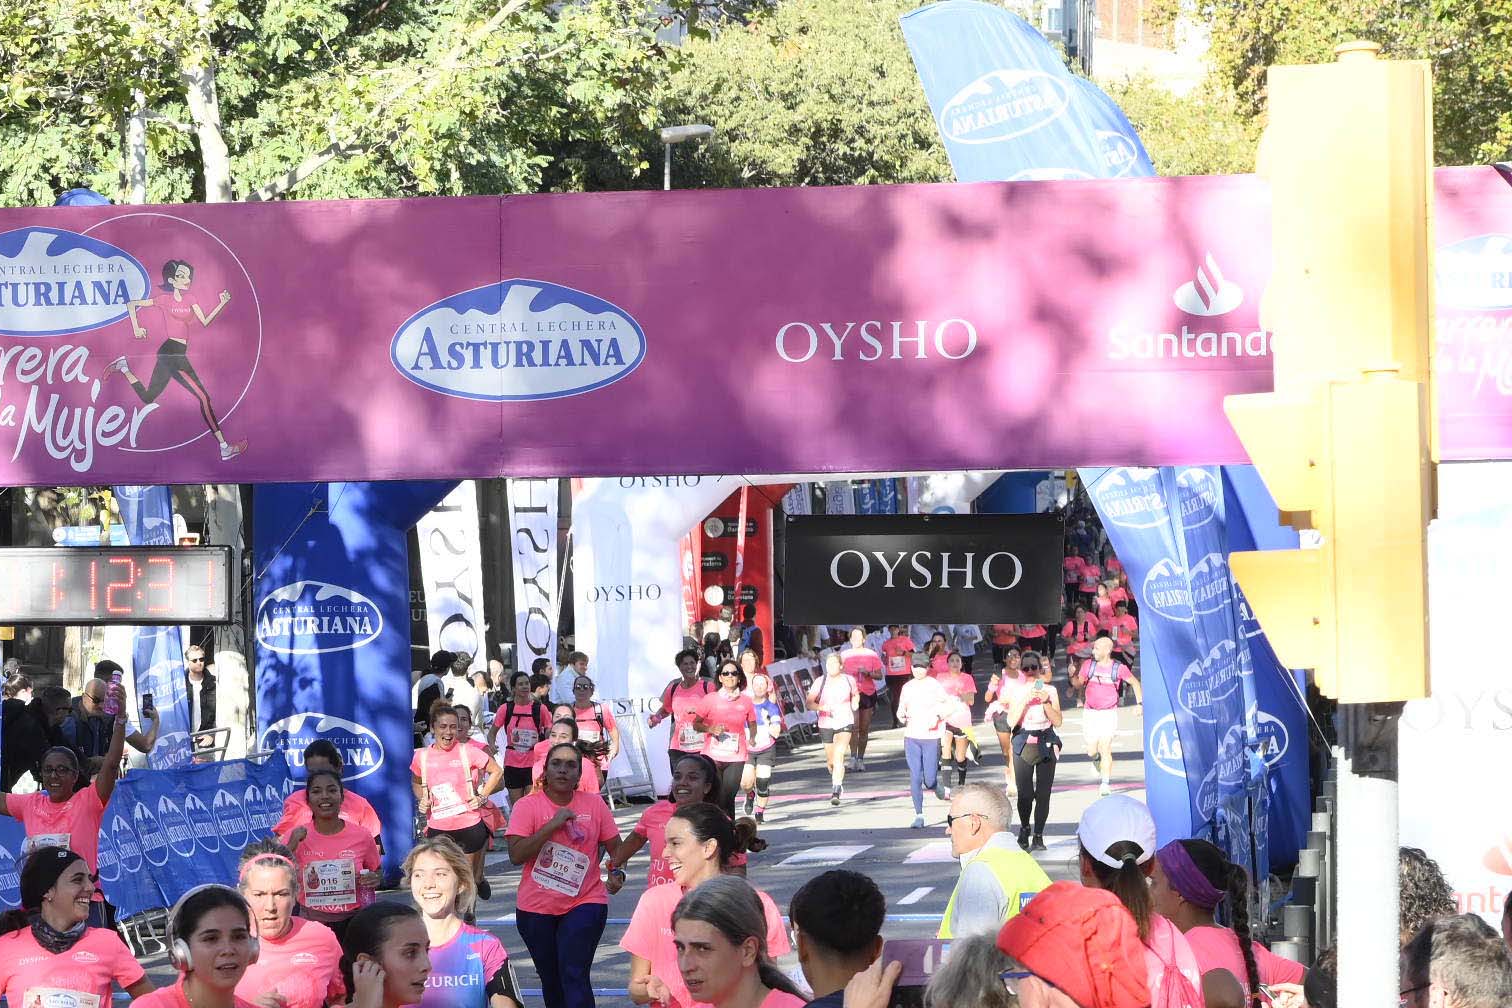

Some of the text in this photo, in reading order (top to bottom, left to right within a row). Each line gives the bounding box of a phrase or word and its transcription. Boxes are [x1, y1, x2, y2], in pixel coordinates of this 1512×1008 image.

[53, 262, 126, 276] LECHERA
[449, 318, 618, 336] CENTRAL LECHERA
[410, 325, 627, 371] ASTURIANA
[775, 318, 979, 363] OYSHO
[10, 377, 161, 473] Mujer
[829, 550, 1024, 591] OYSHO
[586, 583, 662, 603] OYSHO
[272, 603, 369, 615] CENTRAL LECHERA
[259, 611, 374, 639] ASTURIANA
[552, 861, 569, 873] 016
[320, 877, 338, 886] 016
[423, 974, 479, 989] ZURICH
